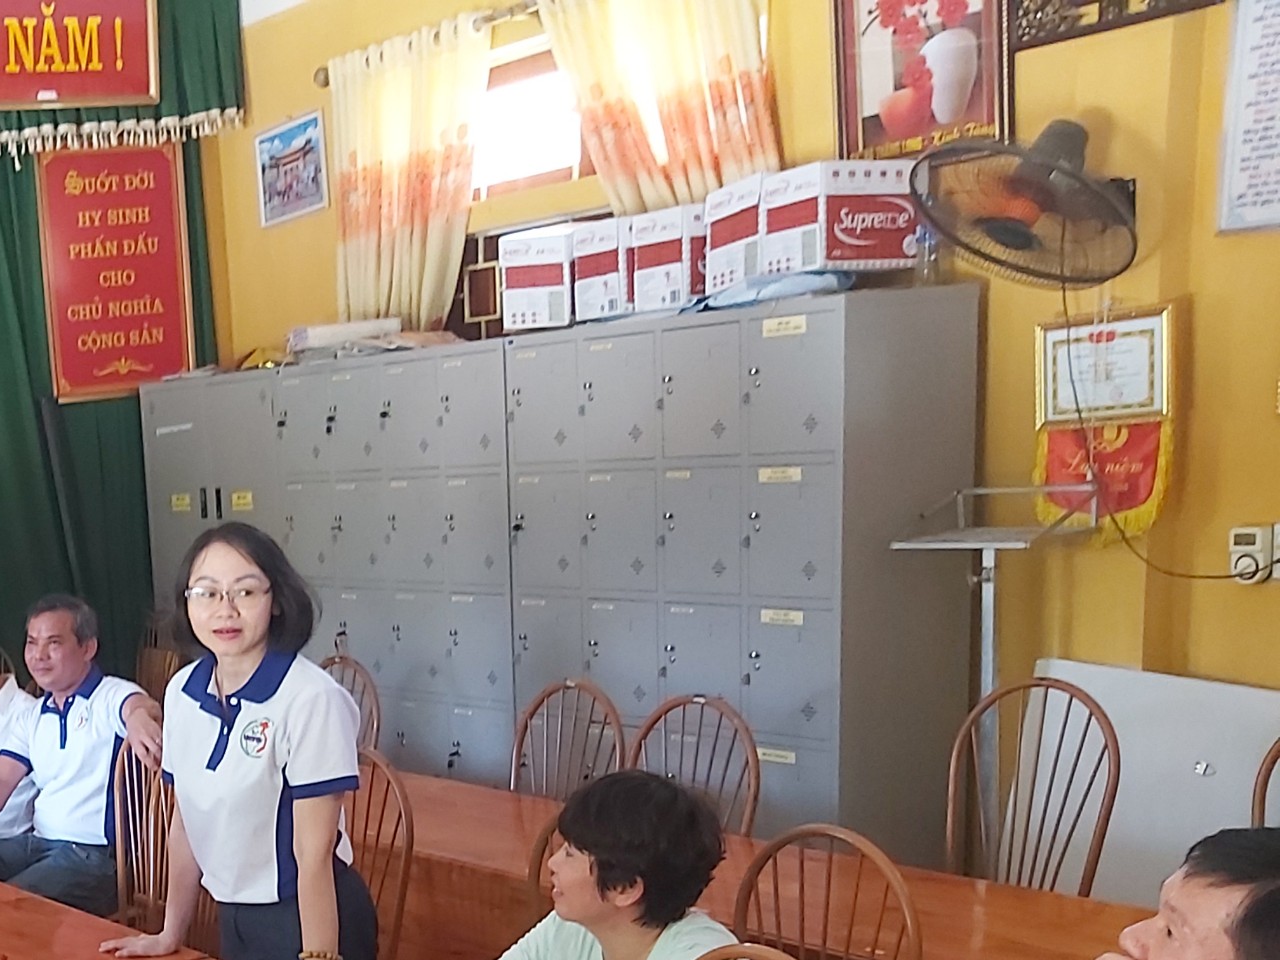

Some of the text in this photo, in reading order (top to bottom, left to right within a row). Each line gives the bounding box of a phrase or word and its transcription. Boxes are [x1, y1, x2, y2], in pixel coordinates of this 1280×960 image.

[4, 1, 104, 74] NĂM
[78, 206, 150, 228] HY SINH
[839, 206, 910, 234] Supreme
[99, 269, 135, 287] CHO
[78, 321, 164, 354] CỘNG SẢN
